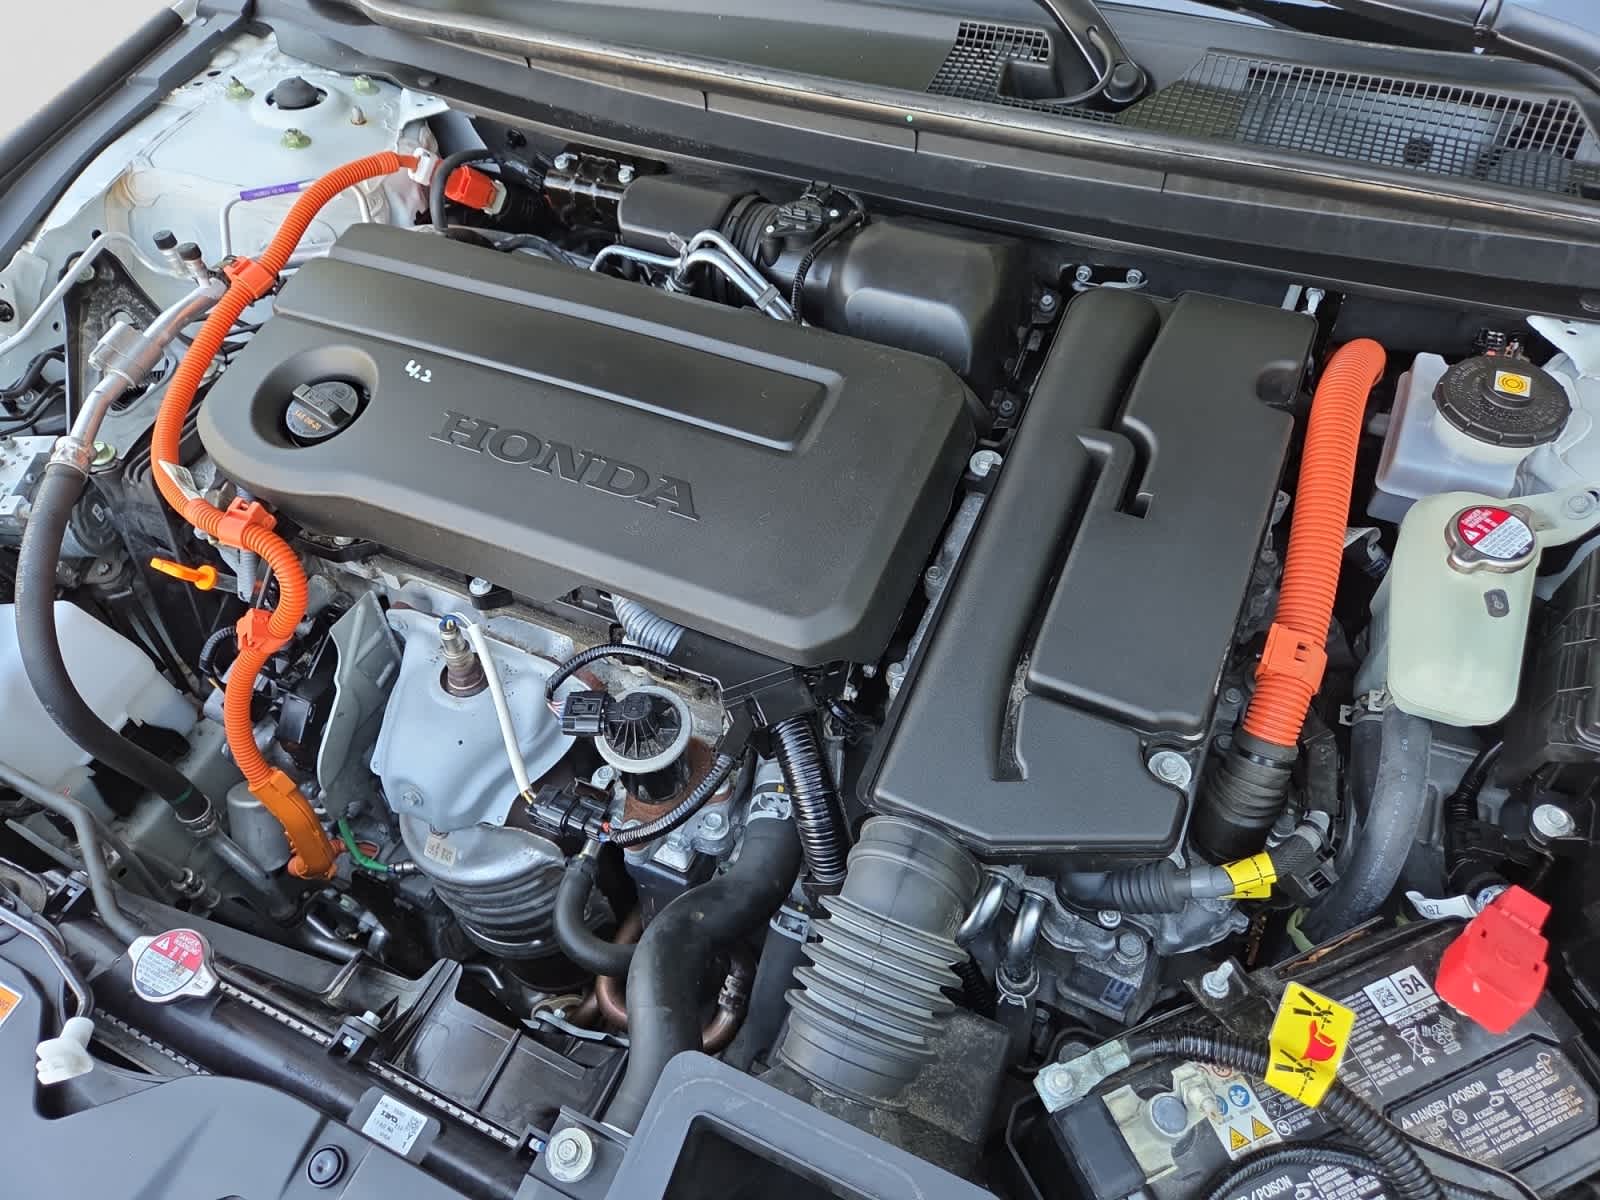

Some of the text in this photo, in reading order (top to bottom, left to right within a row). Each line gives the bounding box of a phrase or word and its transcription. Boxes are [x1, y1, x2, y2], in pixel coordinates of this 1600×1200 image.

[405, 359, 432, 383] 4.2
[428, 410, 700, 521] HONDA
[1398, 974, 1426, 996] 5A
